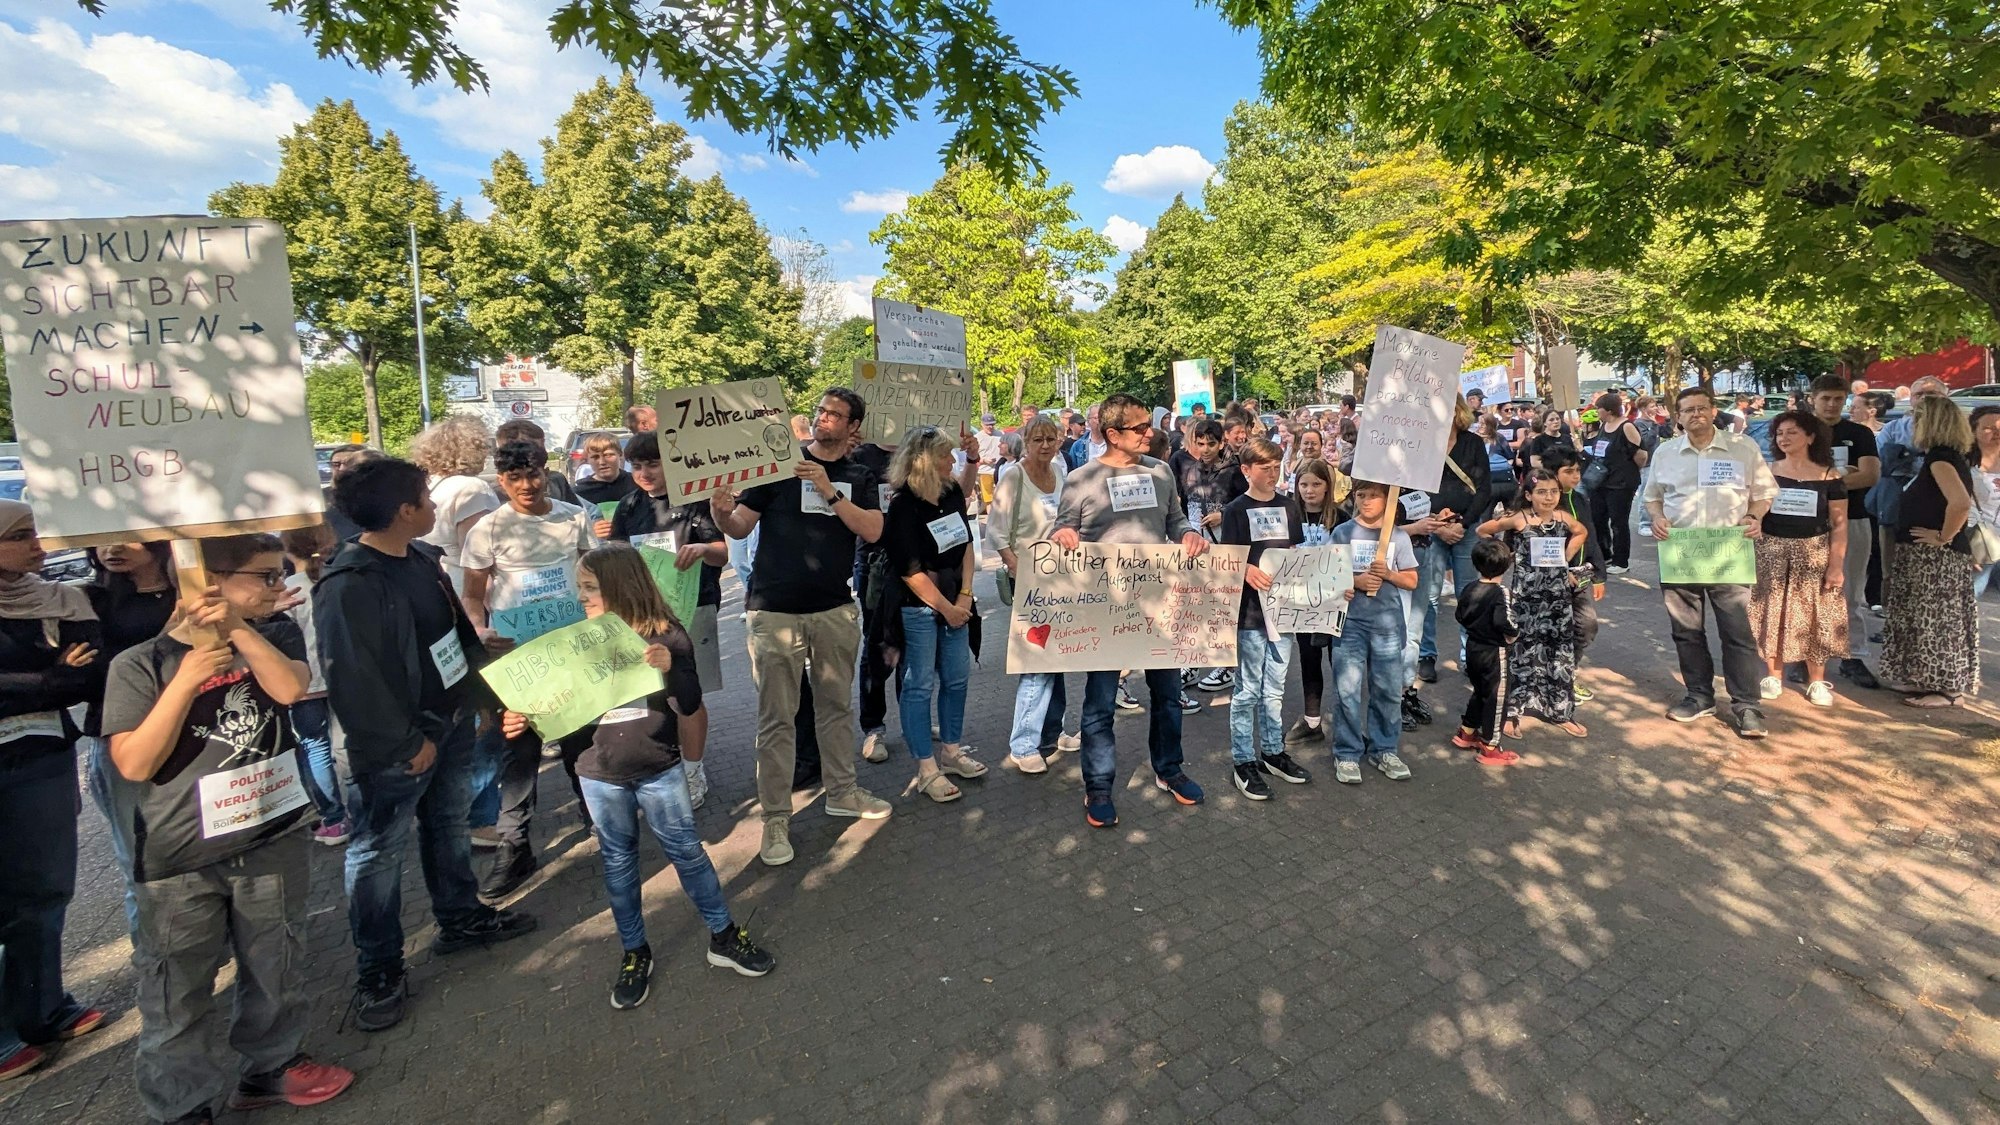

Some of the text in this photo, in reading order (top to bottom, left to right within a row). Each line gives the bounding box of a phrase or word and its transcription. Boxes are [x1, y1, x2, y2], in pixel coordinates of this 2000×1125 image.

[19, 225, 264, 269] ZUKUNFT
[883, 305, 945, 326] Versprechen
[30, 315, 220, 355] MACHEN
[893, 338, 928, 350] gehalten
[1383, 331, 1439, 361] Moderne
[45, 362, 189, 396] SCHUL-
[883, 361, 957, 385] KEINE
[1392, 359, 1444, 396] Bildung
[1377, 387, 1431, 408] braucht
[88, 390, 251, 428] NEUBAU
[675, 399, 691, 429] 7
[694, 396, 743, 427] Jahre
[1382, 414, 1429, 430] moderne
[1370, 429, 1421, 452] Räume!
[79, 449, 183, 486] HBGB
[684, 452, 705, 469] Wie
[1707, 528, 1742, 539] BILDUN
[1028, 541, 1111, 574] Politiker
[1116, 548, 1150, 569] haben
[1156, 553, 1165, 569] in
[1211, 553, 1242, 572] nicht
[1675, 541, 1749, 560] RAUM
[522, 567, 563, 583] BILDUNG
[1097, 571, 1163, 592] Aufgepasst
[522, 580, 567, 597] UMSONST
[1024, 588, 1073, 608] Neubau
[1267, 581, 1322, 608] BAU
[1109, 601, 1135, 615] Finde
[1187, 597, 1203, 606] Mio
[1049, 611, 1073, 624] Mio
[1126, 610, 1140, 620] den
[1182, 610, 1203, 622] Mio
[1052, 626, 1097, 640] Zufriedene
[1180, 622, 1198, 633] Mio
[1189, 652, 1208, 664] Mio
[529, 688, 575, 719] Kein
[230, 768, 274, 789] POLITIK
[215, 775, 293, 809] VERLÄSSLICH?
